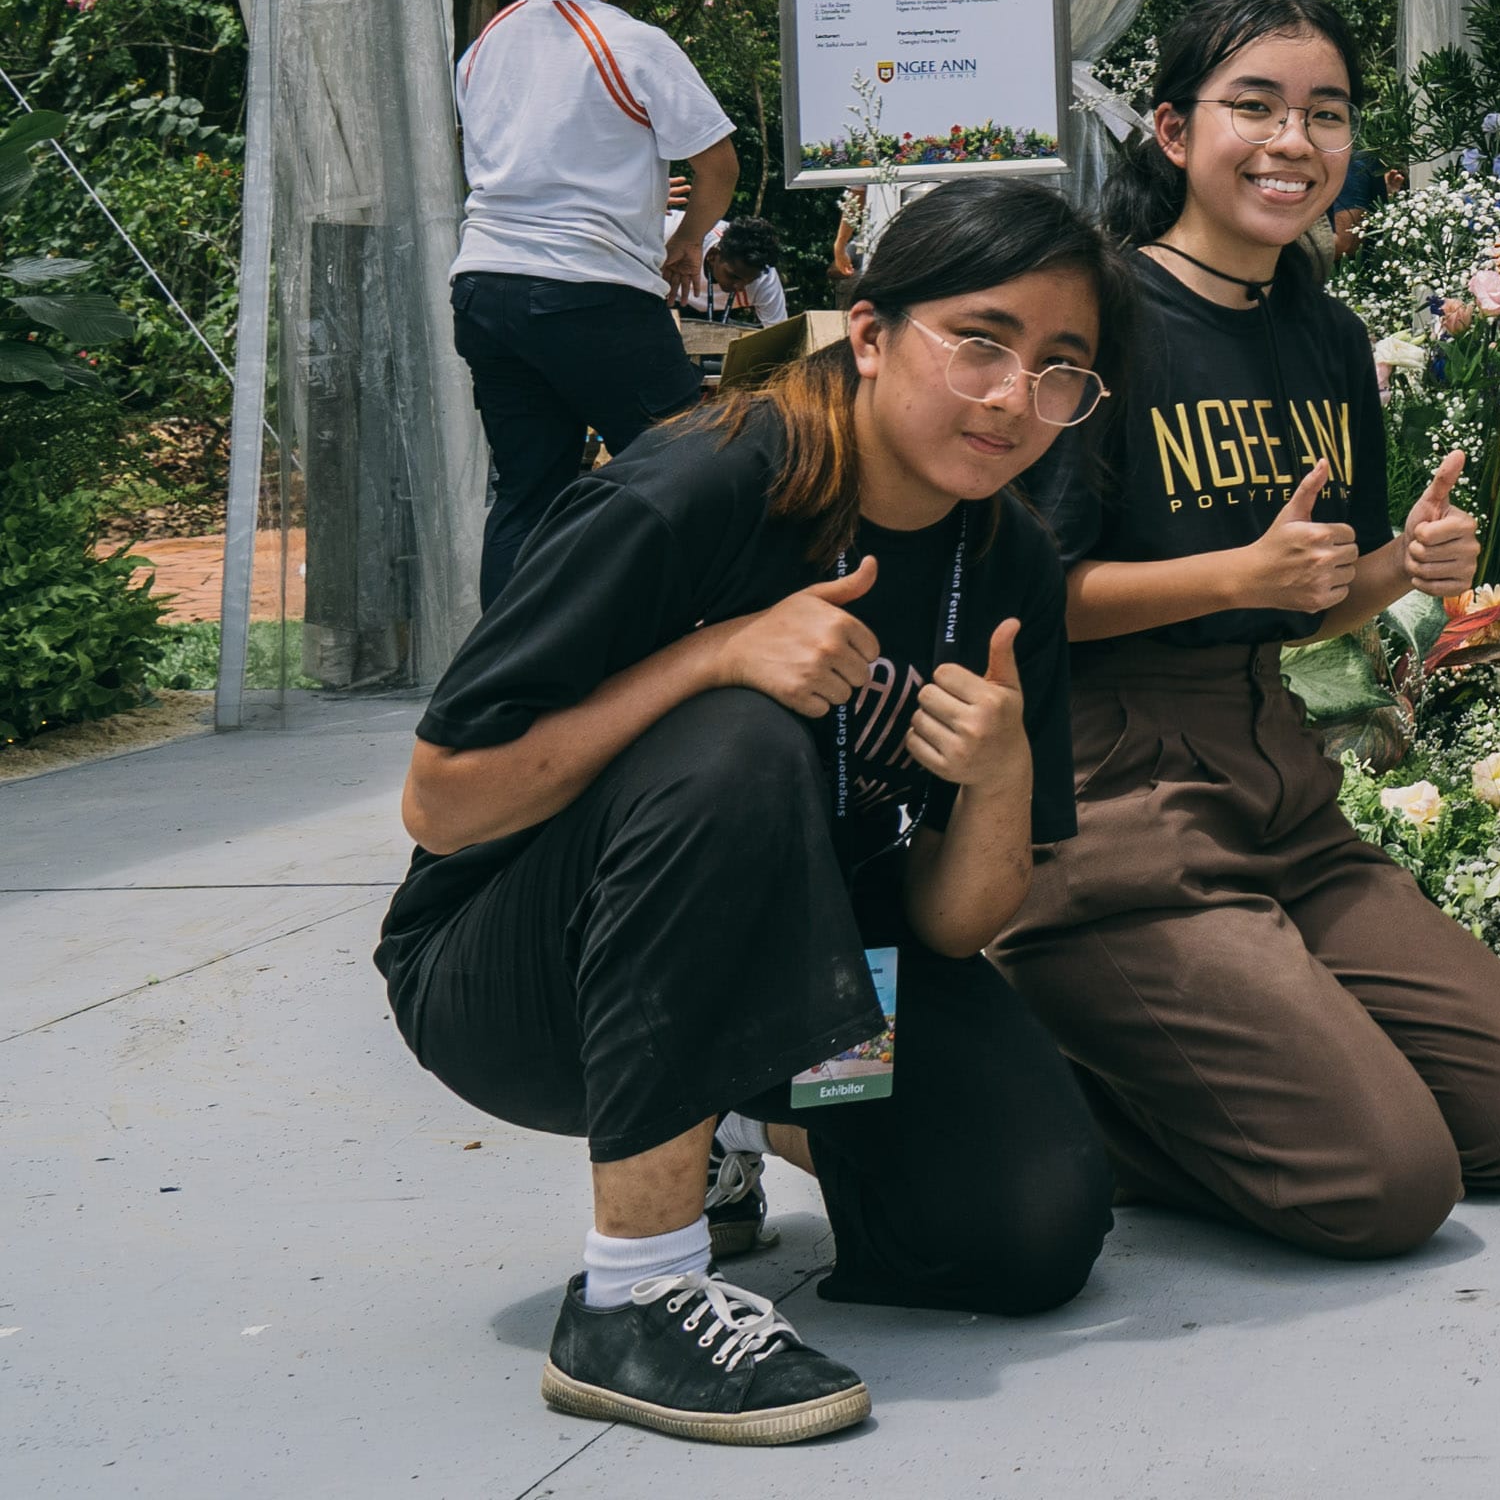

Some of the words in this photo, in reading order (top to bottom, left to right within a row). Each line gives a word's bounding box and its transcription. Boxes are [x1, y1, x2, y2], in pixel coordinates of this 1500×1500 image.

[897, 60, 936, 73] NGEE
[941, 59, 976, 72] ANN
[1151, 400, 1292, 495] NGEE
[951, 541, 966, 588] Garden
[945, 592, 961, 643] Festival
[836, 704, 847, 746] Garde
[837, 750, 848, 817] Singapore
[820, 1083, 865, 1098] Exhibitor
